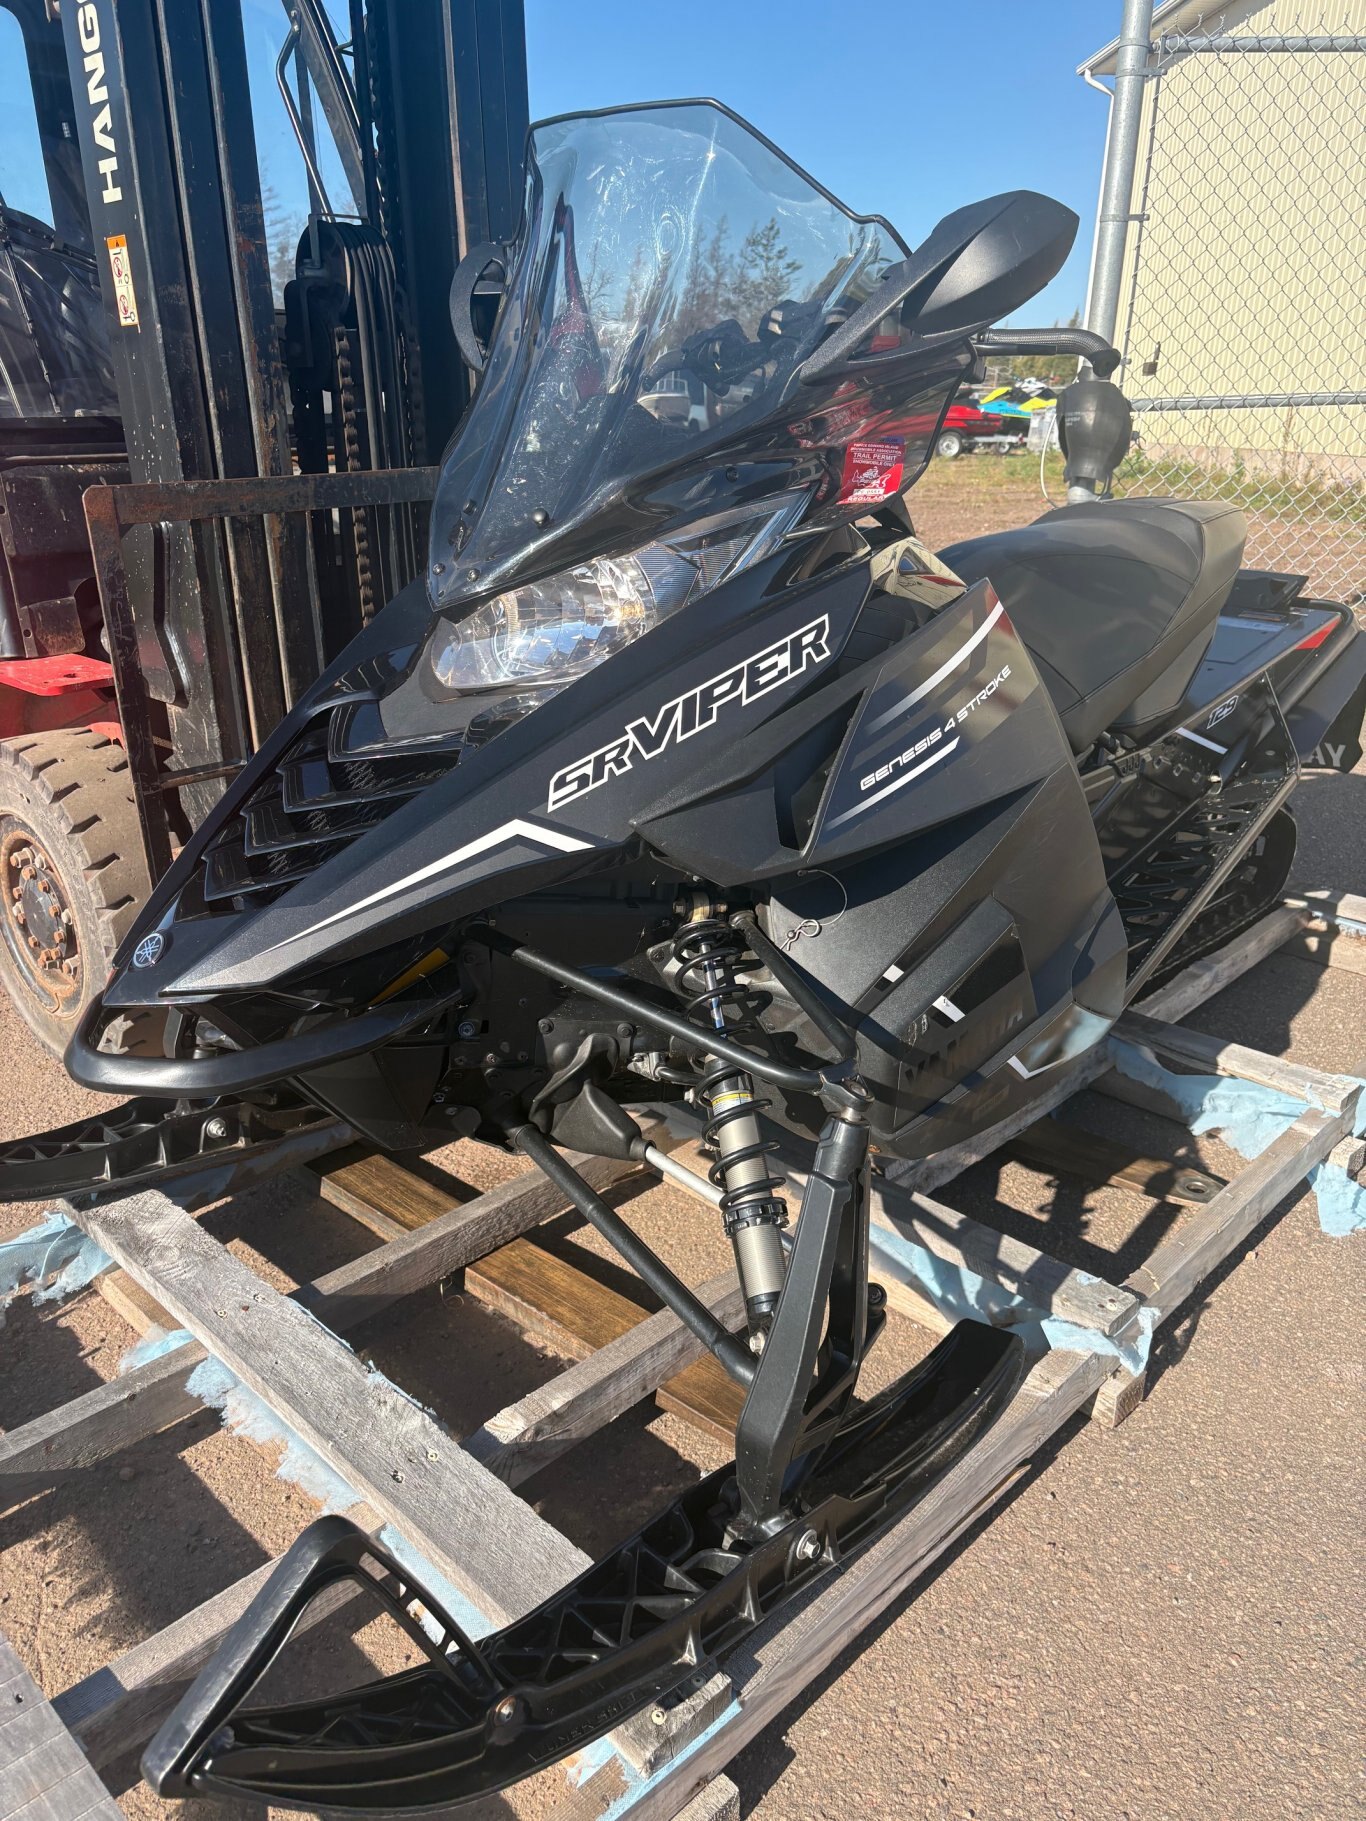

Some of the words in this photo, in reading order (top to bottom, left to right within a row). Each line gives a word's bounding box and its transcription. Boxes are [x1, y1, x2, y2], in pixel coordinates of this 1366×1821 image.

[78, 0, 122, 204] HANG
[853, 452, 871, 460] TRAIL
[873, 453, 897, 461] PERMIT
[860, 727, 942, 791] GENESIS
[944, 717, 956, 733] 4
[956, 664, 1012, 723] STROKE
[1207, 695, 1239, 729] 129
